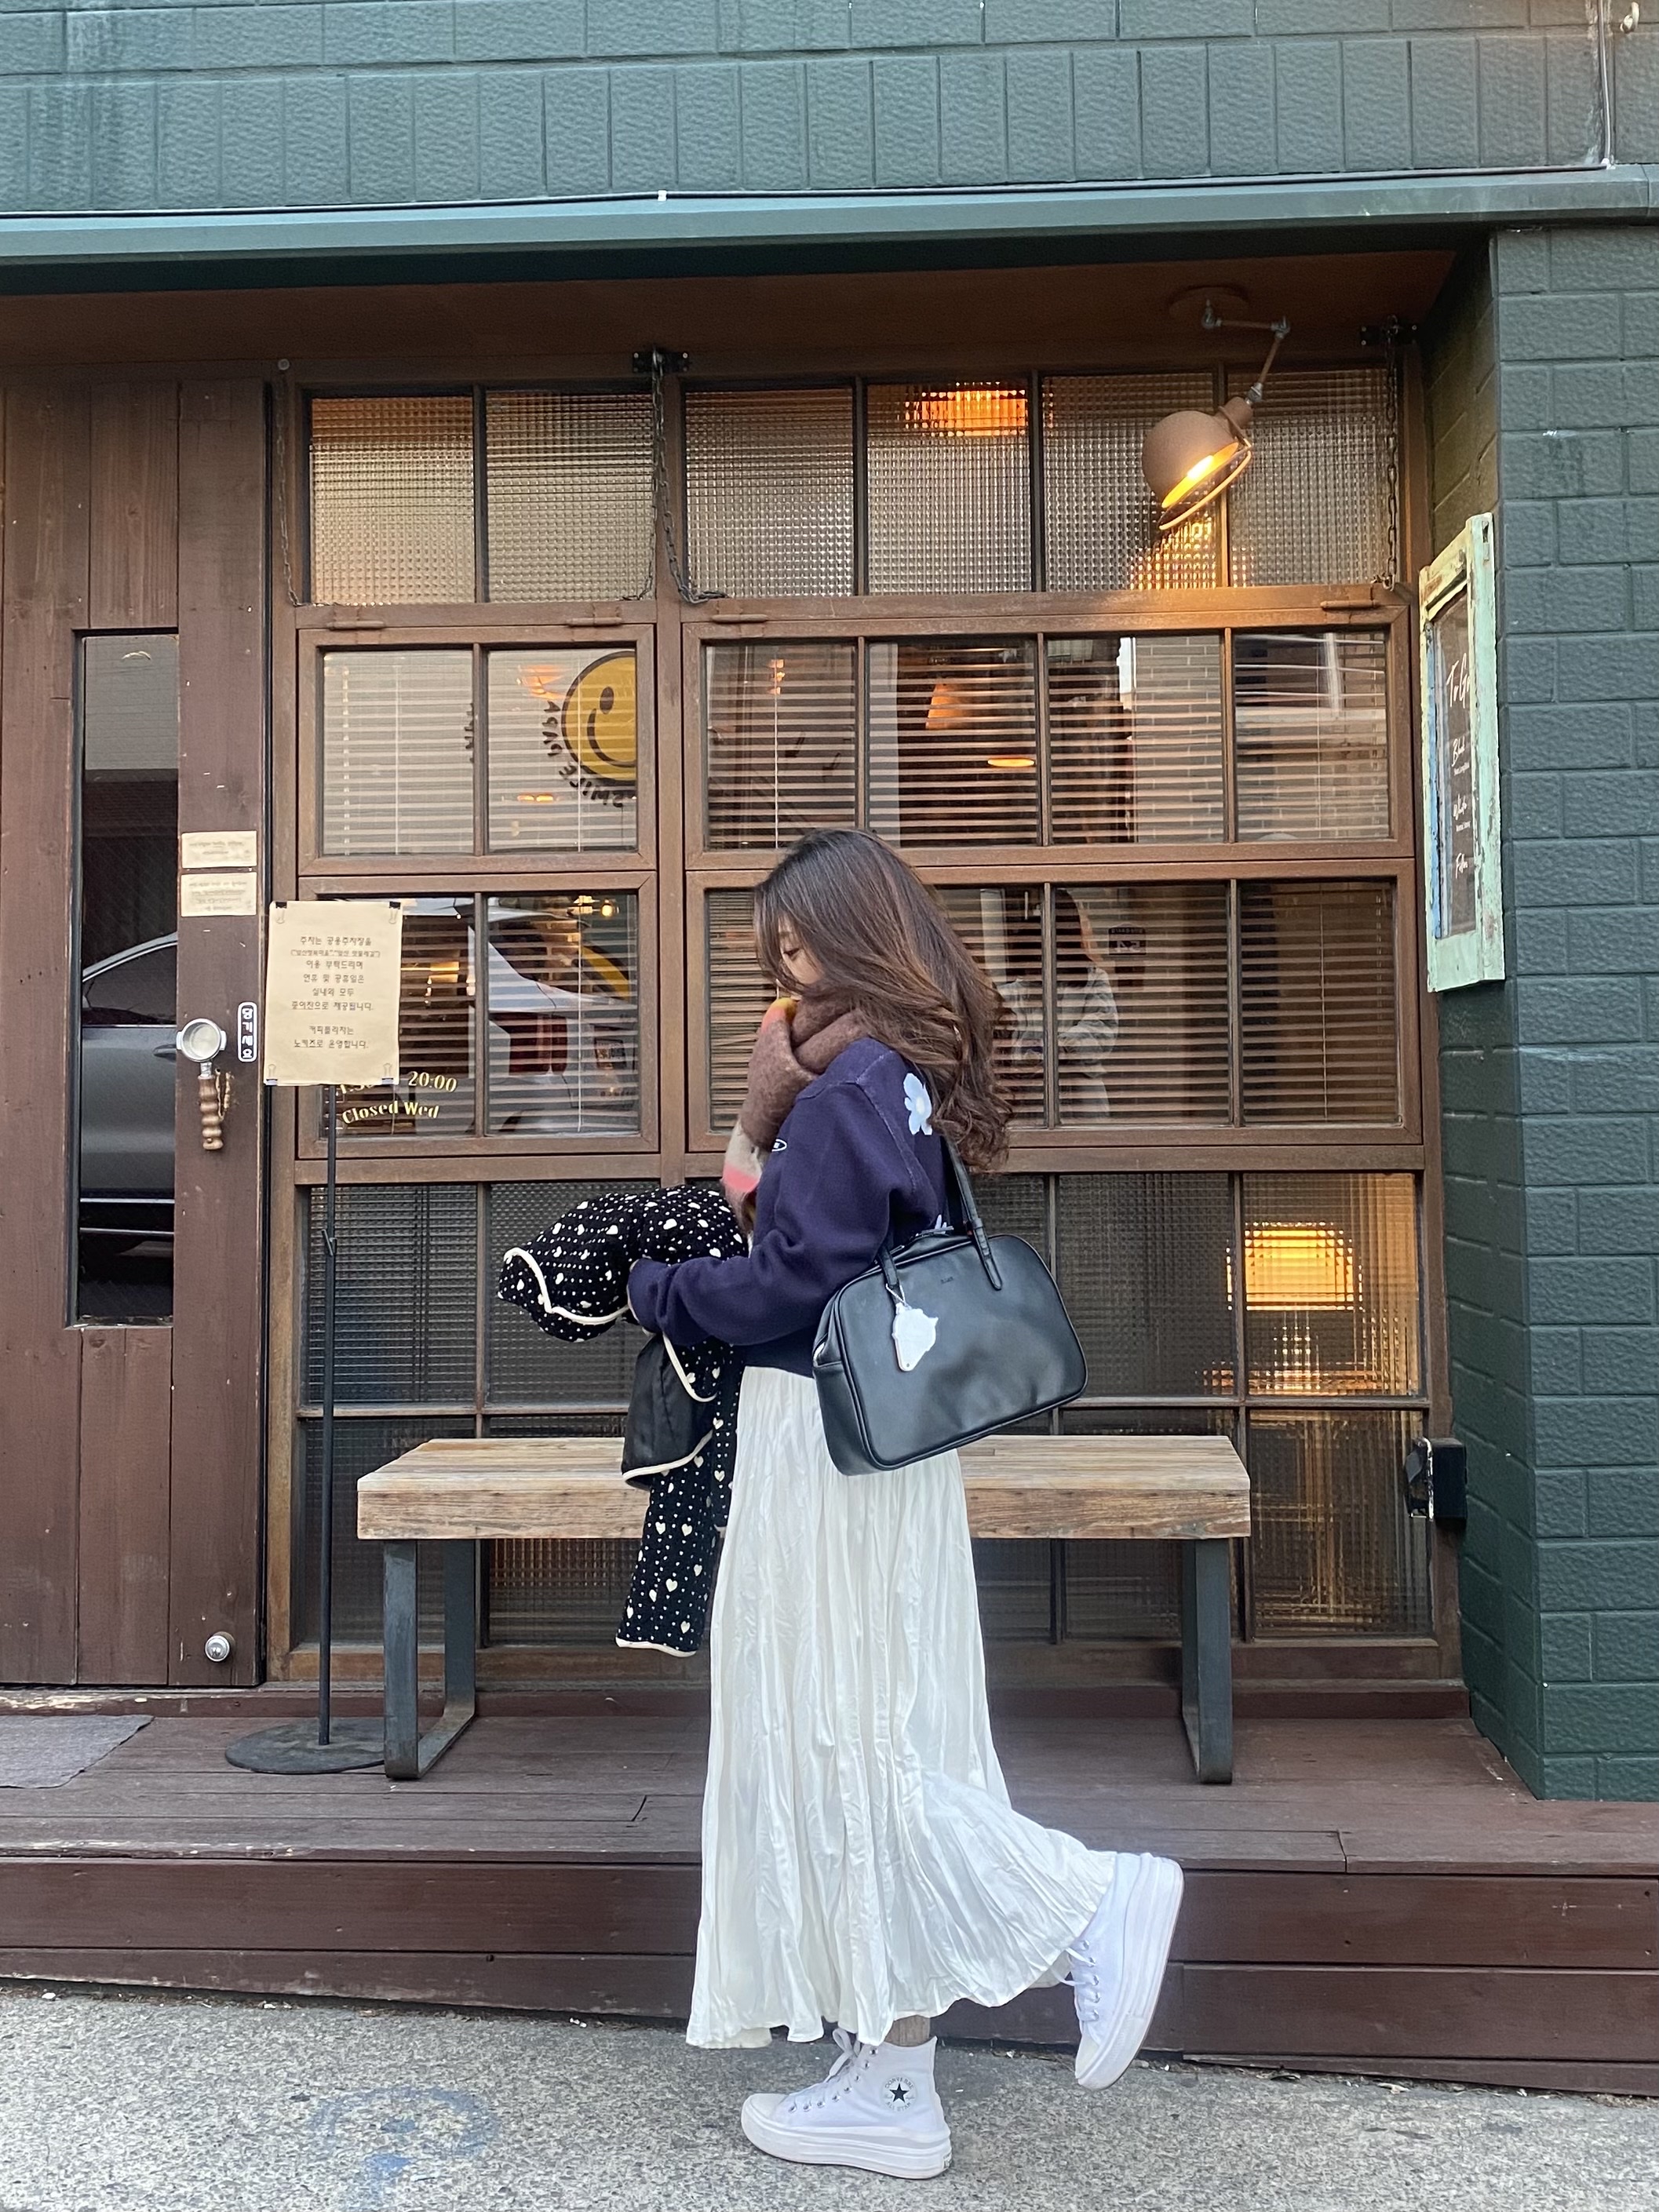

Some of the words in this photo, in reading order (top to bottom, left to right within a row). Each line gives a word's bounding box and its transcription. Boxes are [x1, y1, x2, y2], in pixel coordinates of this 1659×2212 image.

[306, 960, 321, 969] 이용
[408, 1070, 458, 1093] 20:00
[341, 1100, 399, 1124] Closed
[403, 1101, 440, 1119] Wed
